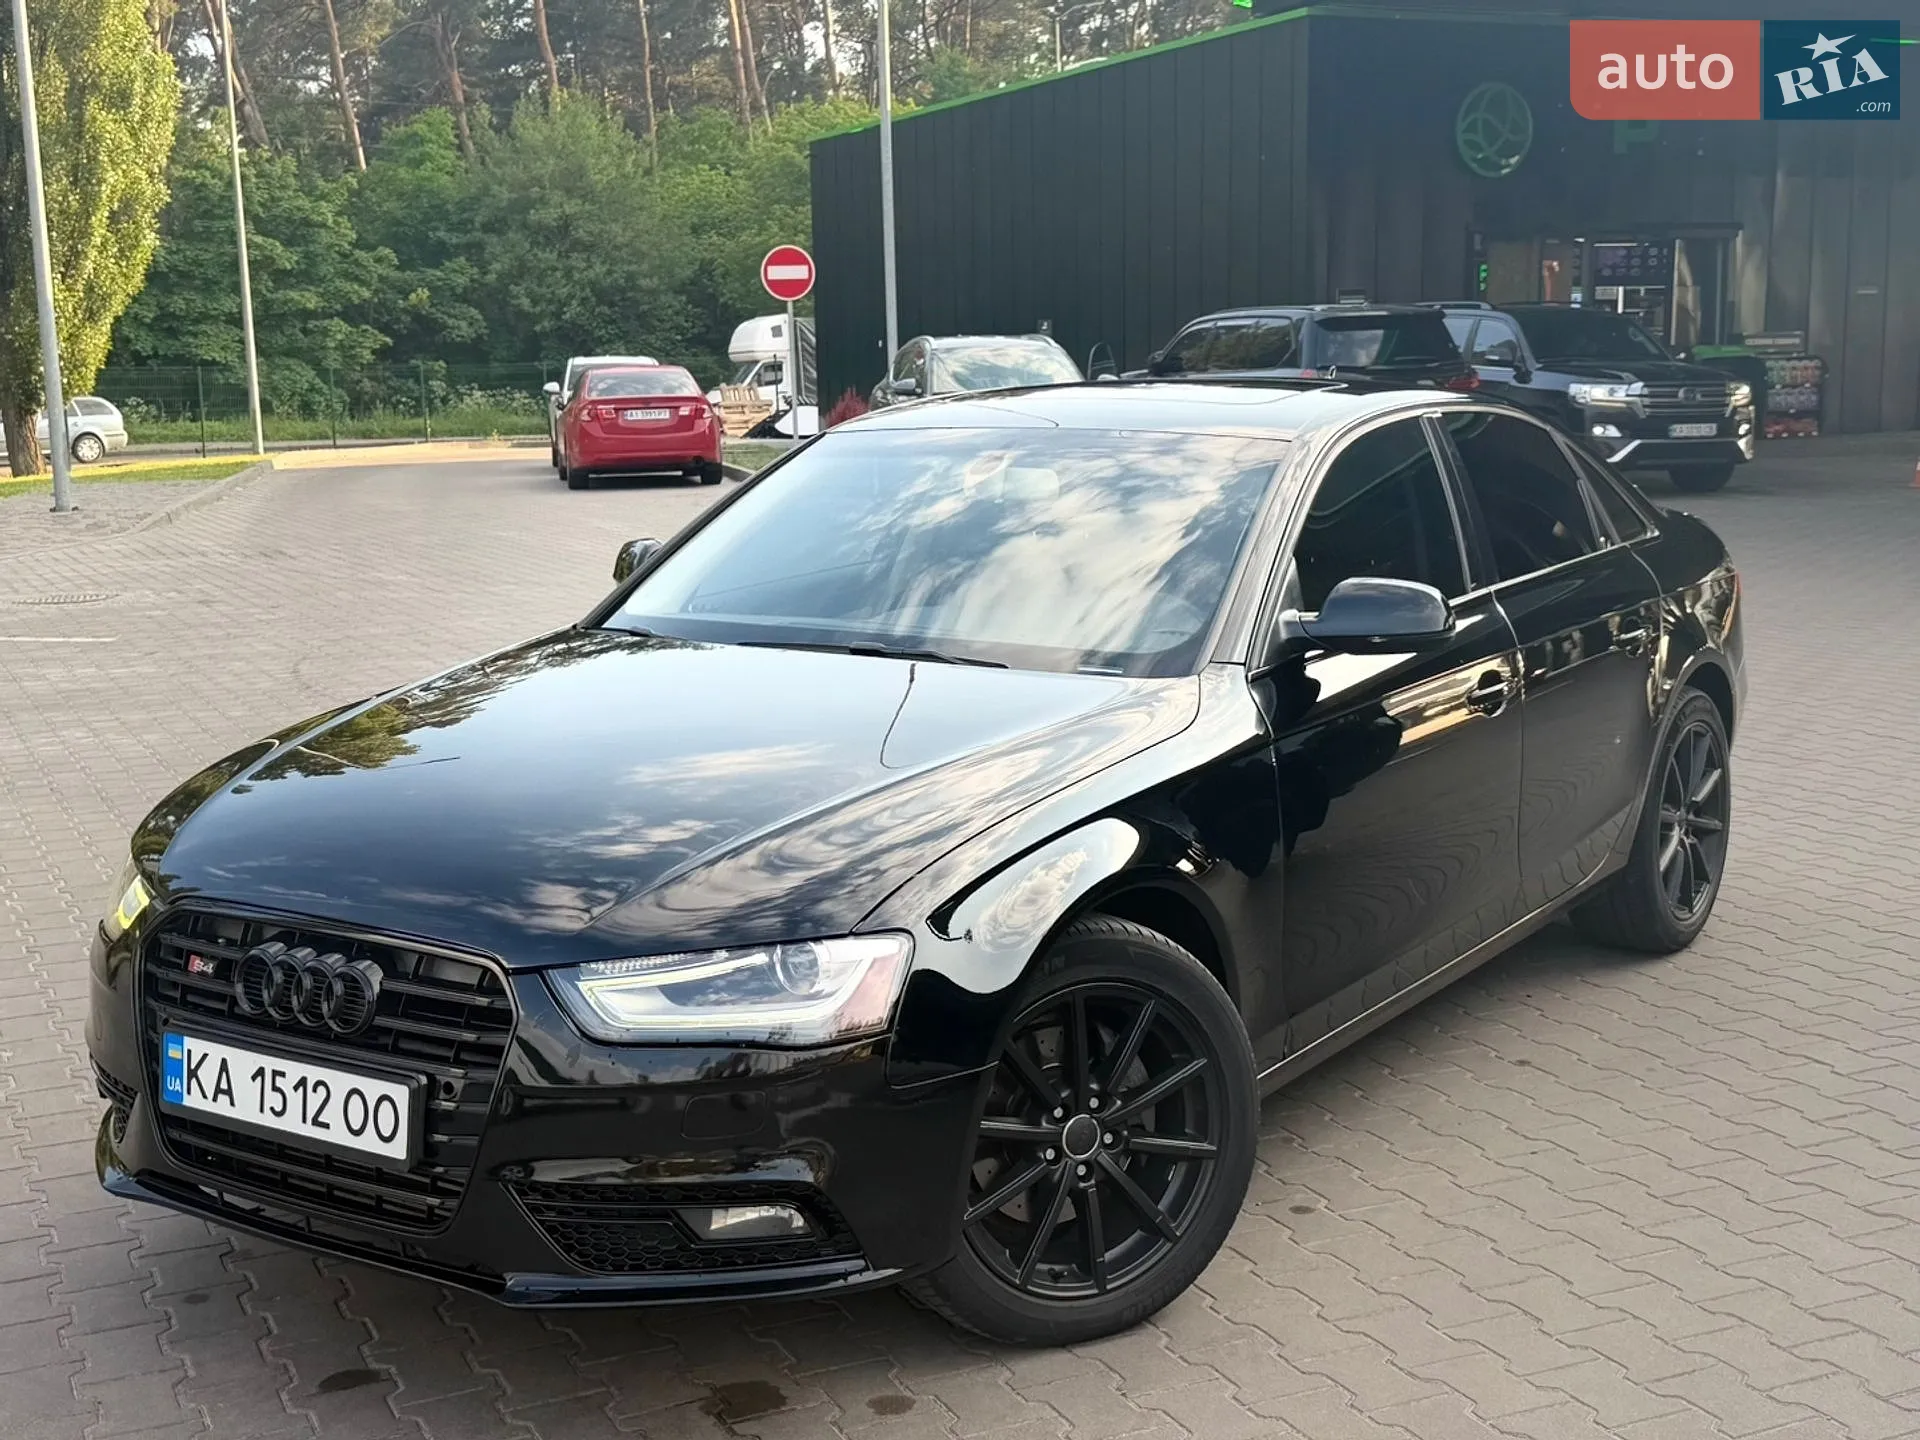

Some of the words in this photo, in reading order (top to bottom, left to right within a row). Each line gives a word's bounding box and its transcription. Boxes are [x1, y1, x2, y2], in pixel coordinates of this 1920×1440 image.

[167, 1075, 182, 1093] UA
[186, 1049, 236, 1107] KA
[251, 1066, 330, 1130] 1512
